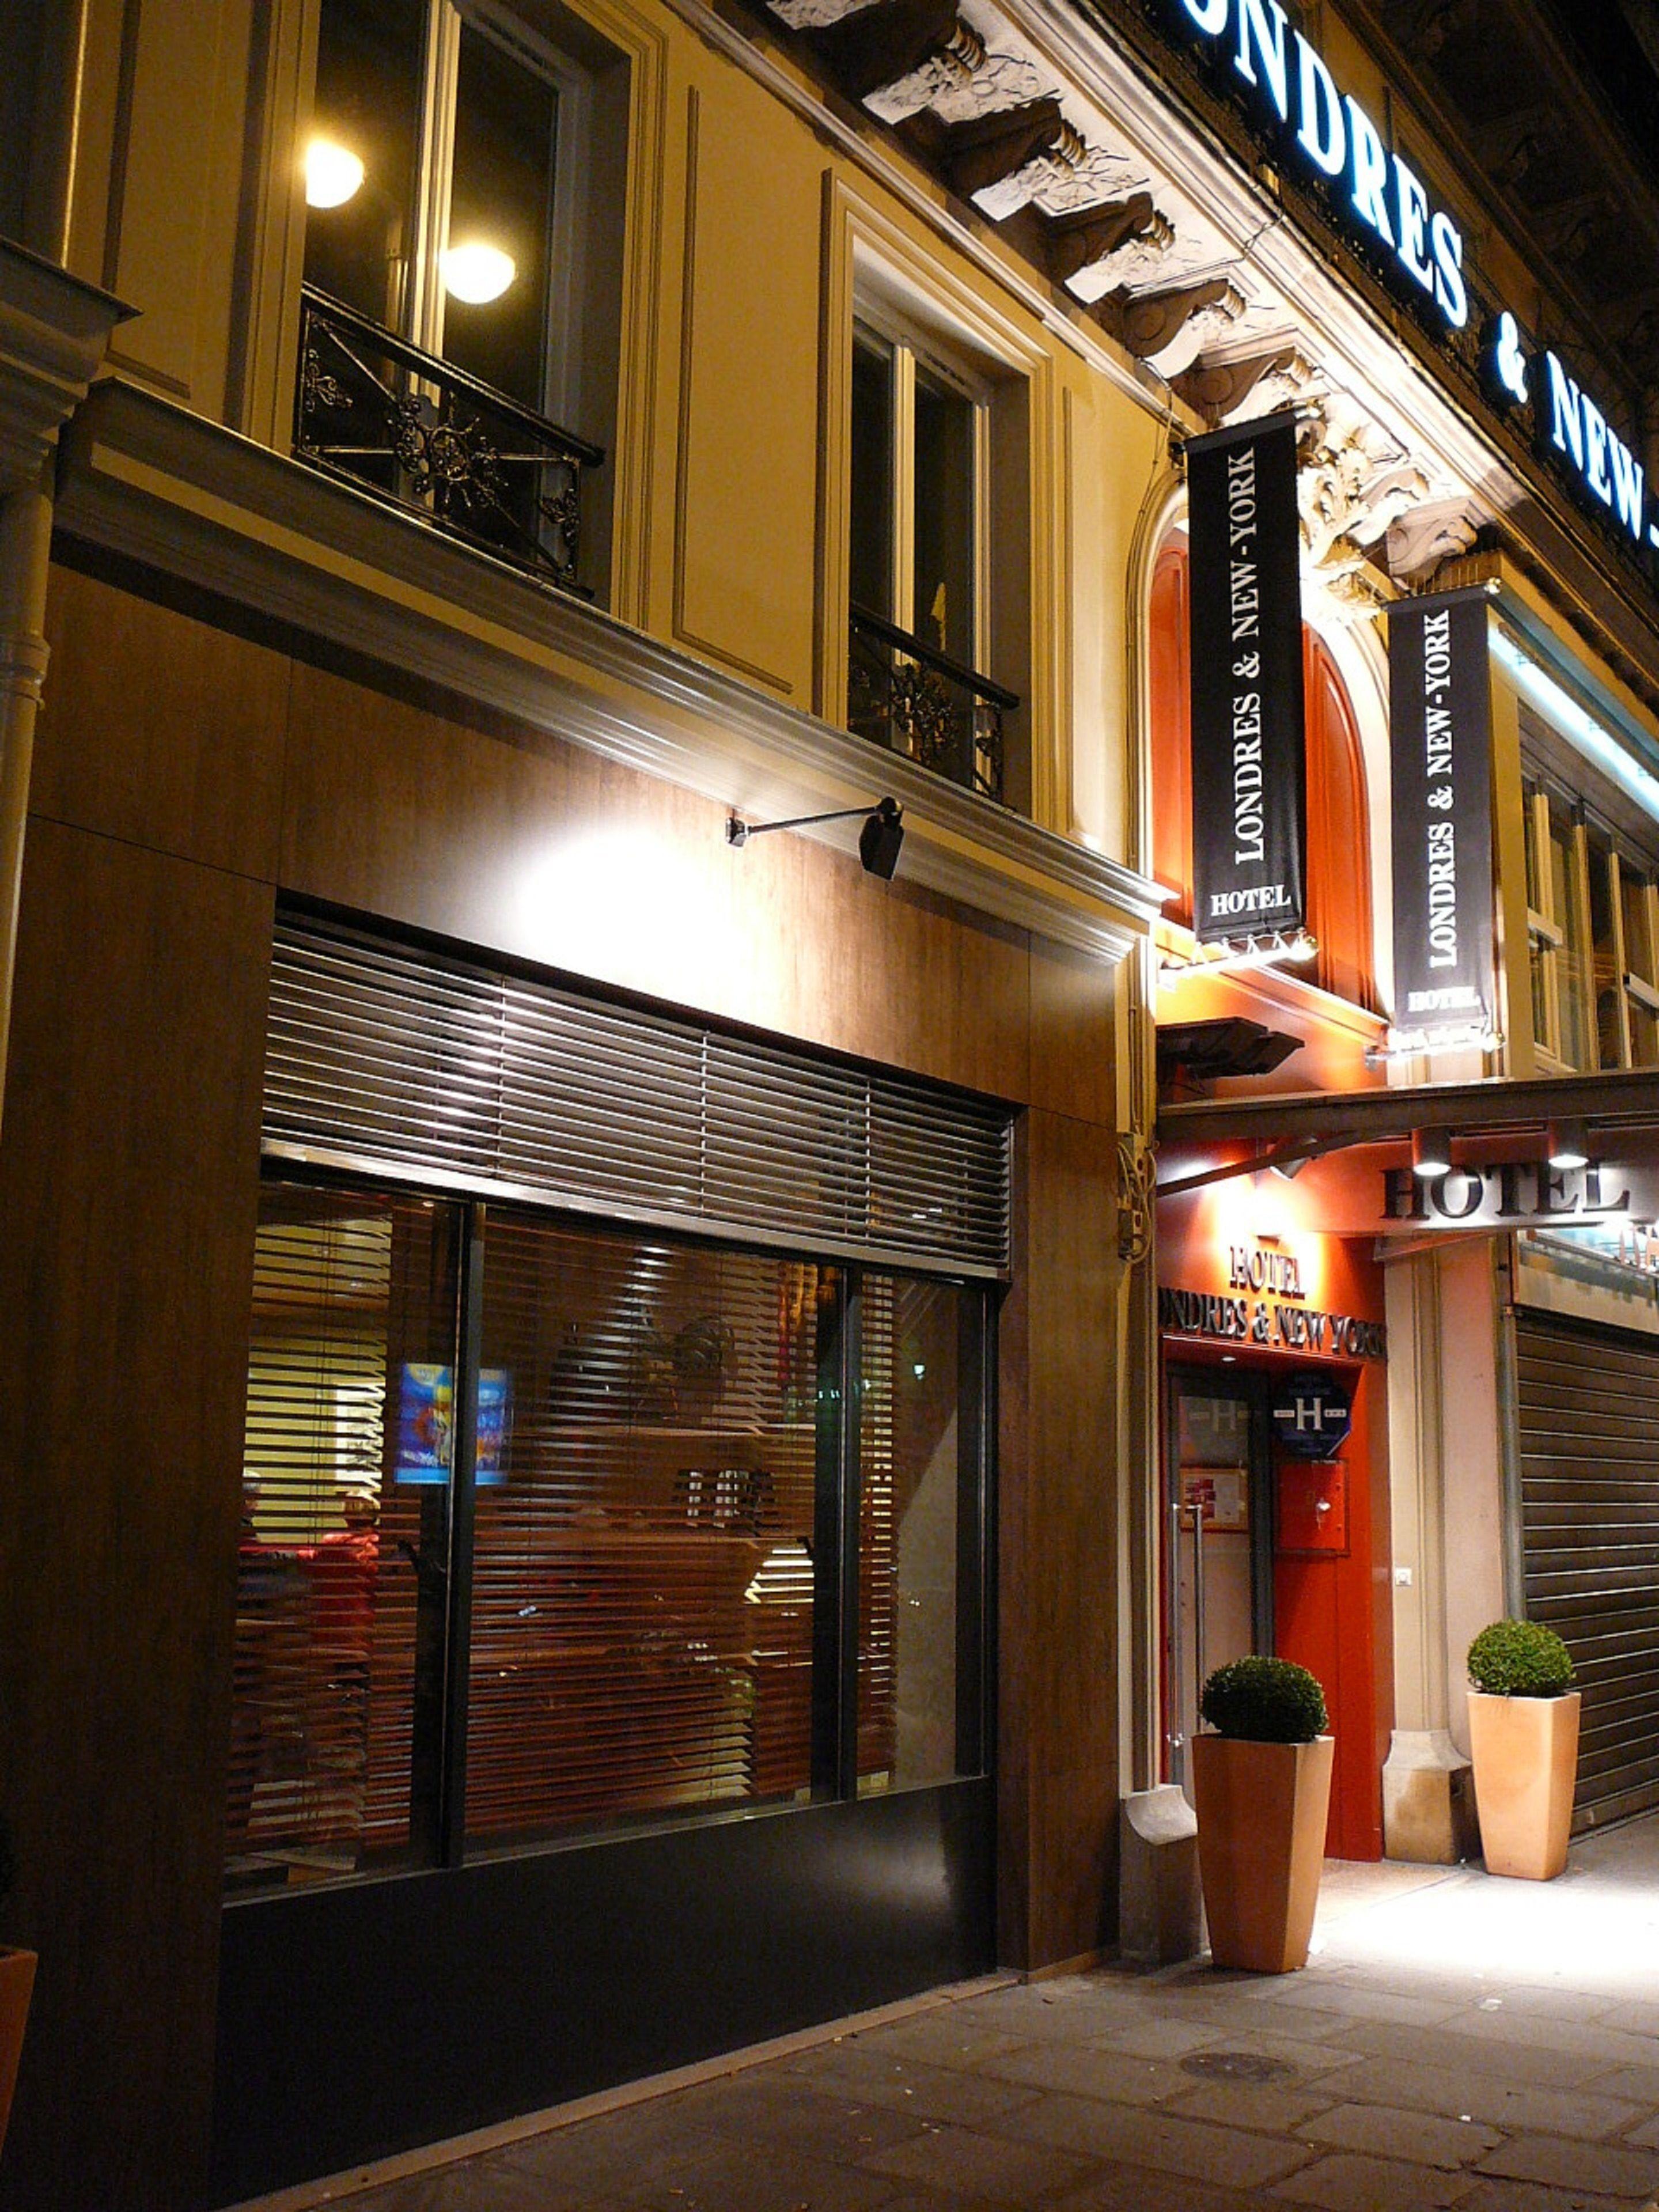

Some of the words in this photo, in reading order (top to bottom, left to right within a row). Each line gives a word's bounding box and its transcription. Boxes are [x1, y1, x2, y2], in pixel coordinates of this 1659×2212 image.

[1497, 311, 1528, 403] &
[1228, 446, 1259, 642] NEW-YORK
[1232, 651, 1260, 679] &
[1423, 609, 1452, 778] NEW-YORK
[1233, 692, 1264, 865] LONDRES
[1427, 786, 1453, 810] &
[1210, 885, 1291, 916] HOTEL
[1428, 822, 1457, 968] LONDRES
[1408, 986, 1481, 1012] HOTEL
[1379, 1161, 1630, 1220] HOTEL
[1229, 1245, 1306, 1300] HOTEL
[1252, 1302, 1270, 1345] &
[1274, 1304, 1325, 1351] NEW
[1296, 1397, 1323, 1430] H
